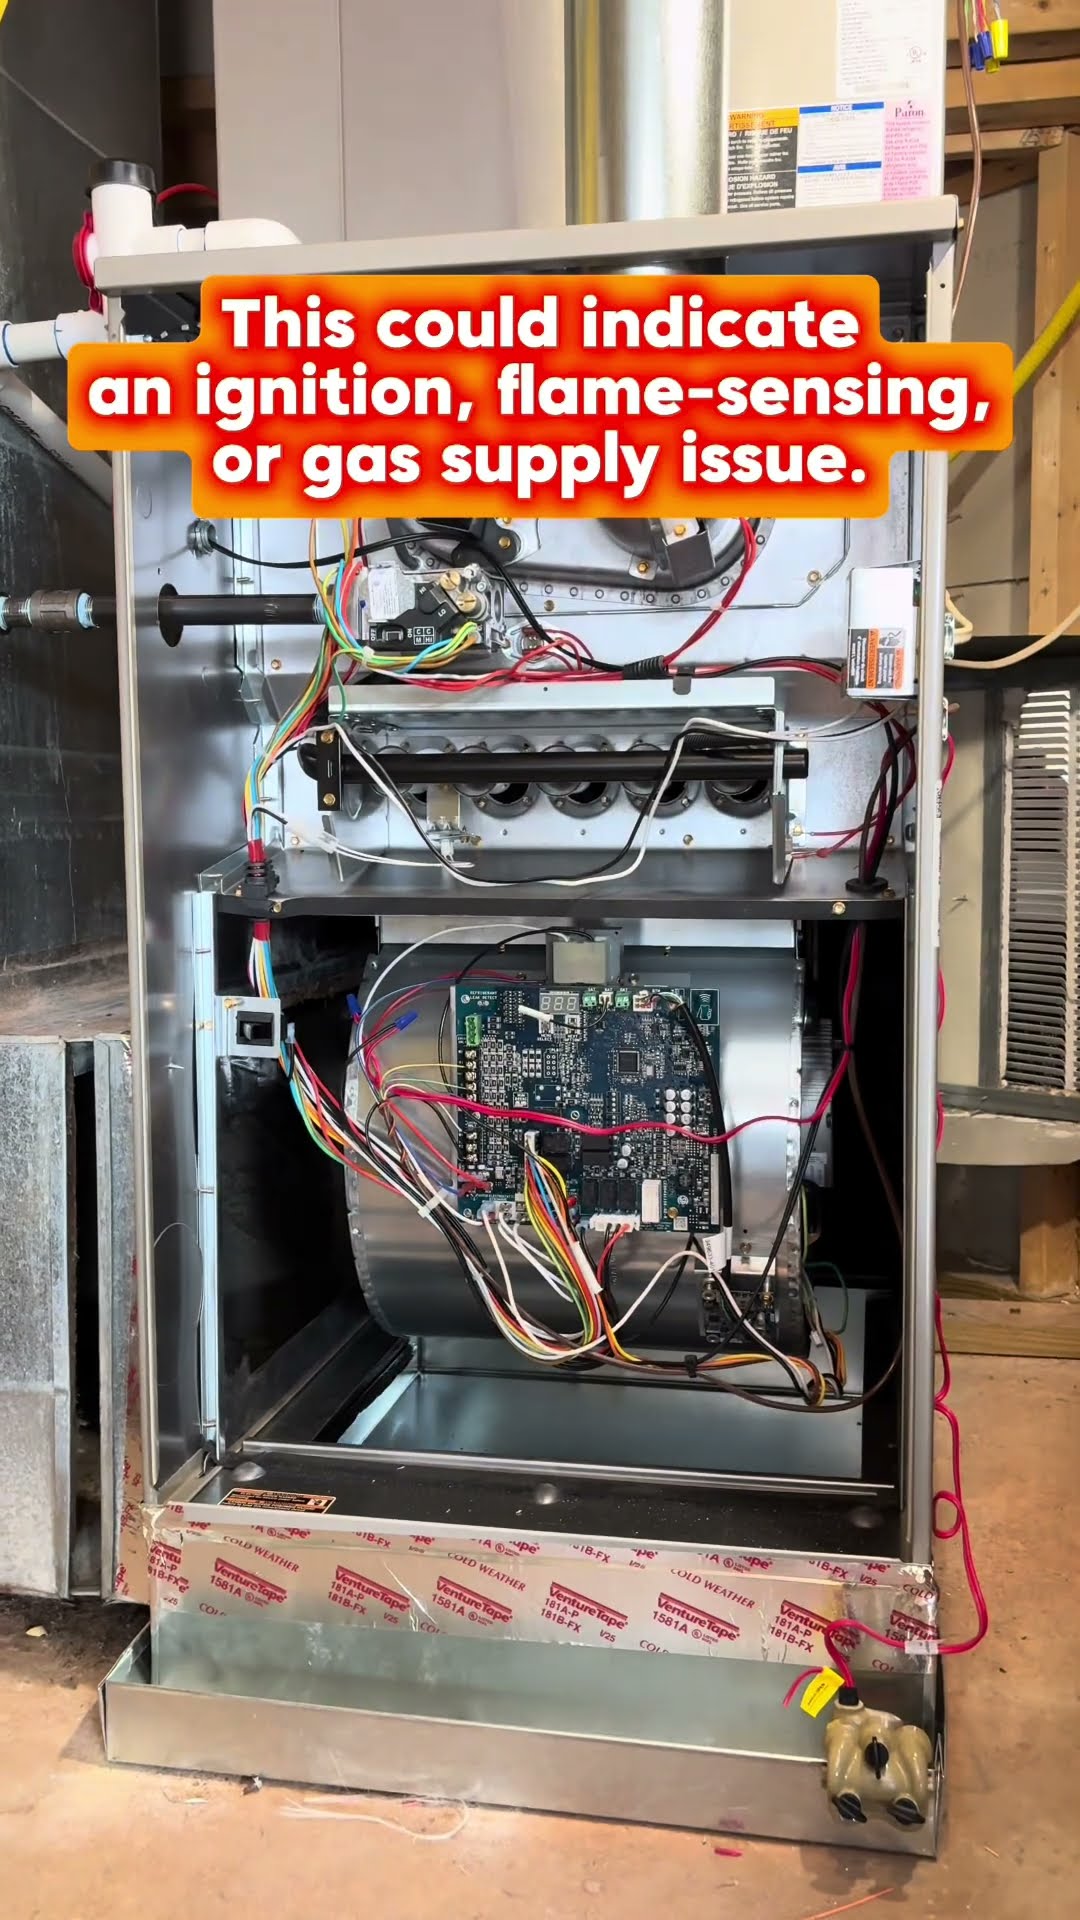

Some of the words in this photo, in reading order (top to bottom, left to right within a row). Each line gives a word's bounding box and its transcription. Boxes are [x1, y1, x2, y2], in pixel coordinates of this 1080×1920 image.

[419, 586, 427, 595] HI
[438, 608, 447, 617] LO
[223, 1535, 252, 1550] COLD
[254, 1545, 300, 1573] WEATHER
[214, 1560, 287, 1604] VentureTape
[447, 1552, 477, 1568] COLD
[479, 1563, 526, 1592] WEATHER
[210, 1575, 242, 1598] 1581A
[331, 1581, 365, 1600] 181A-P
[335, 1567, 410, 1612] VentureTape
[670, 1568, 702, 1585] COLD
[703, 1579, 756, 1609] WEATHER
[327, 1591, 367, 1615] 181B-FX
[432, 1593, 465, 1617] 1581A
[436, 1579, 513, 1623] VentureTape
[545, 1597, 580, 1618] 181A-P
[549, 1585, 628, 1630] VentureTape
[540, 1608, 582, 1633] 181B-FX
[652, 1610, 688, 1635] 1581A
[657, 1597, 740, 1641] VentureTape
[774, 1615, 812, 1638] 181A-P
[769, 1626, 814, 1654] 181B-FX
